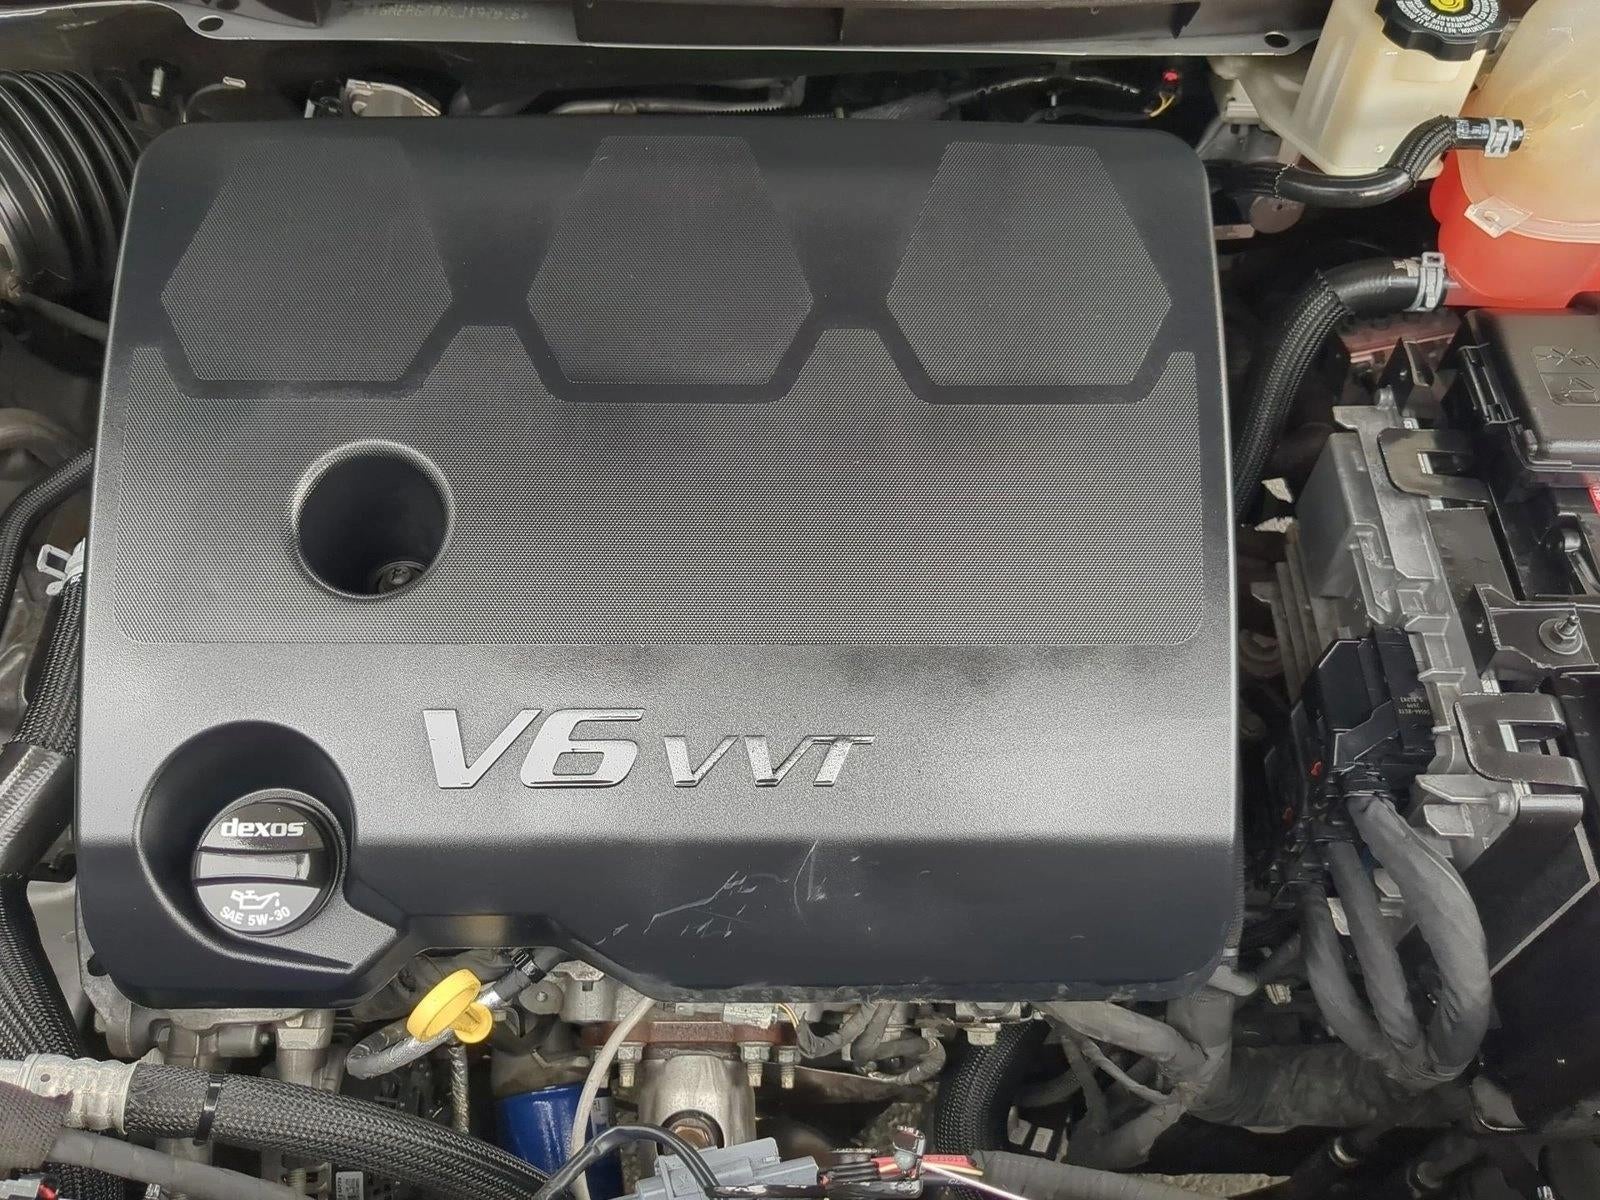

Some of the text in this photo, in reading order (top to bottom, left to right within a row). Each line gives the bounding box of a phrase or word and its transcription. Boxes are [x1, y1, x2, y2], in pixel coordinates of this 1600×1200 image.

[422, 707, 876, 789] V6 VVT
[220, 817, 305, 837] dexos
[219, 905, 290, 926] SAE 5W-30
